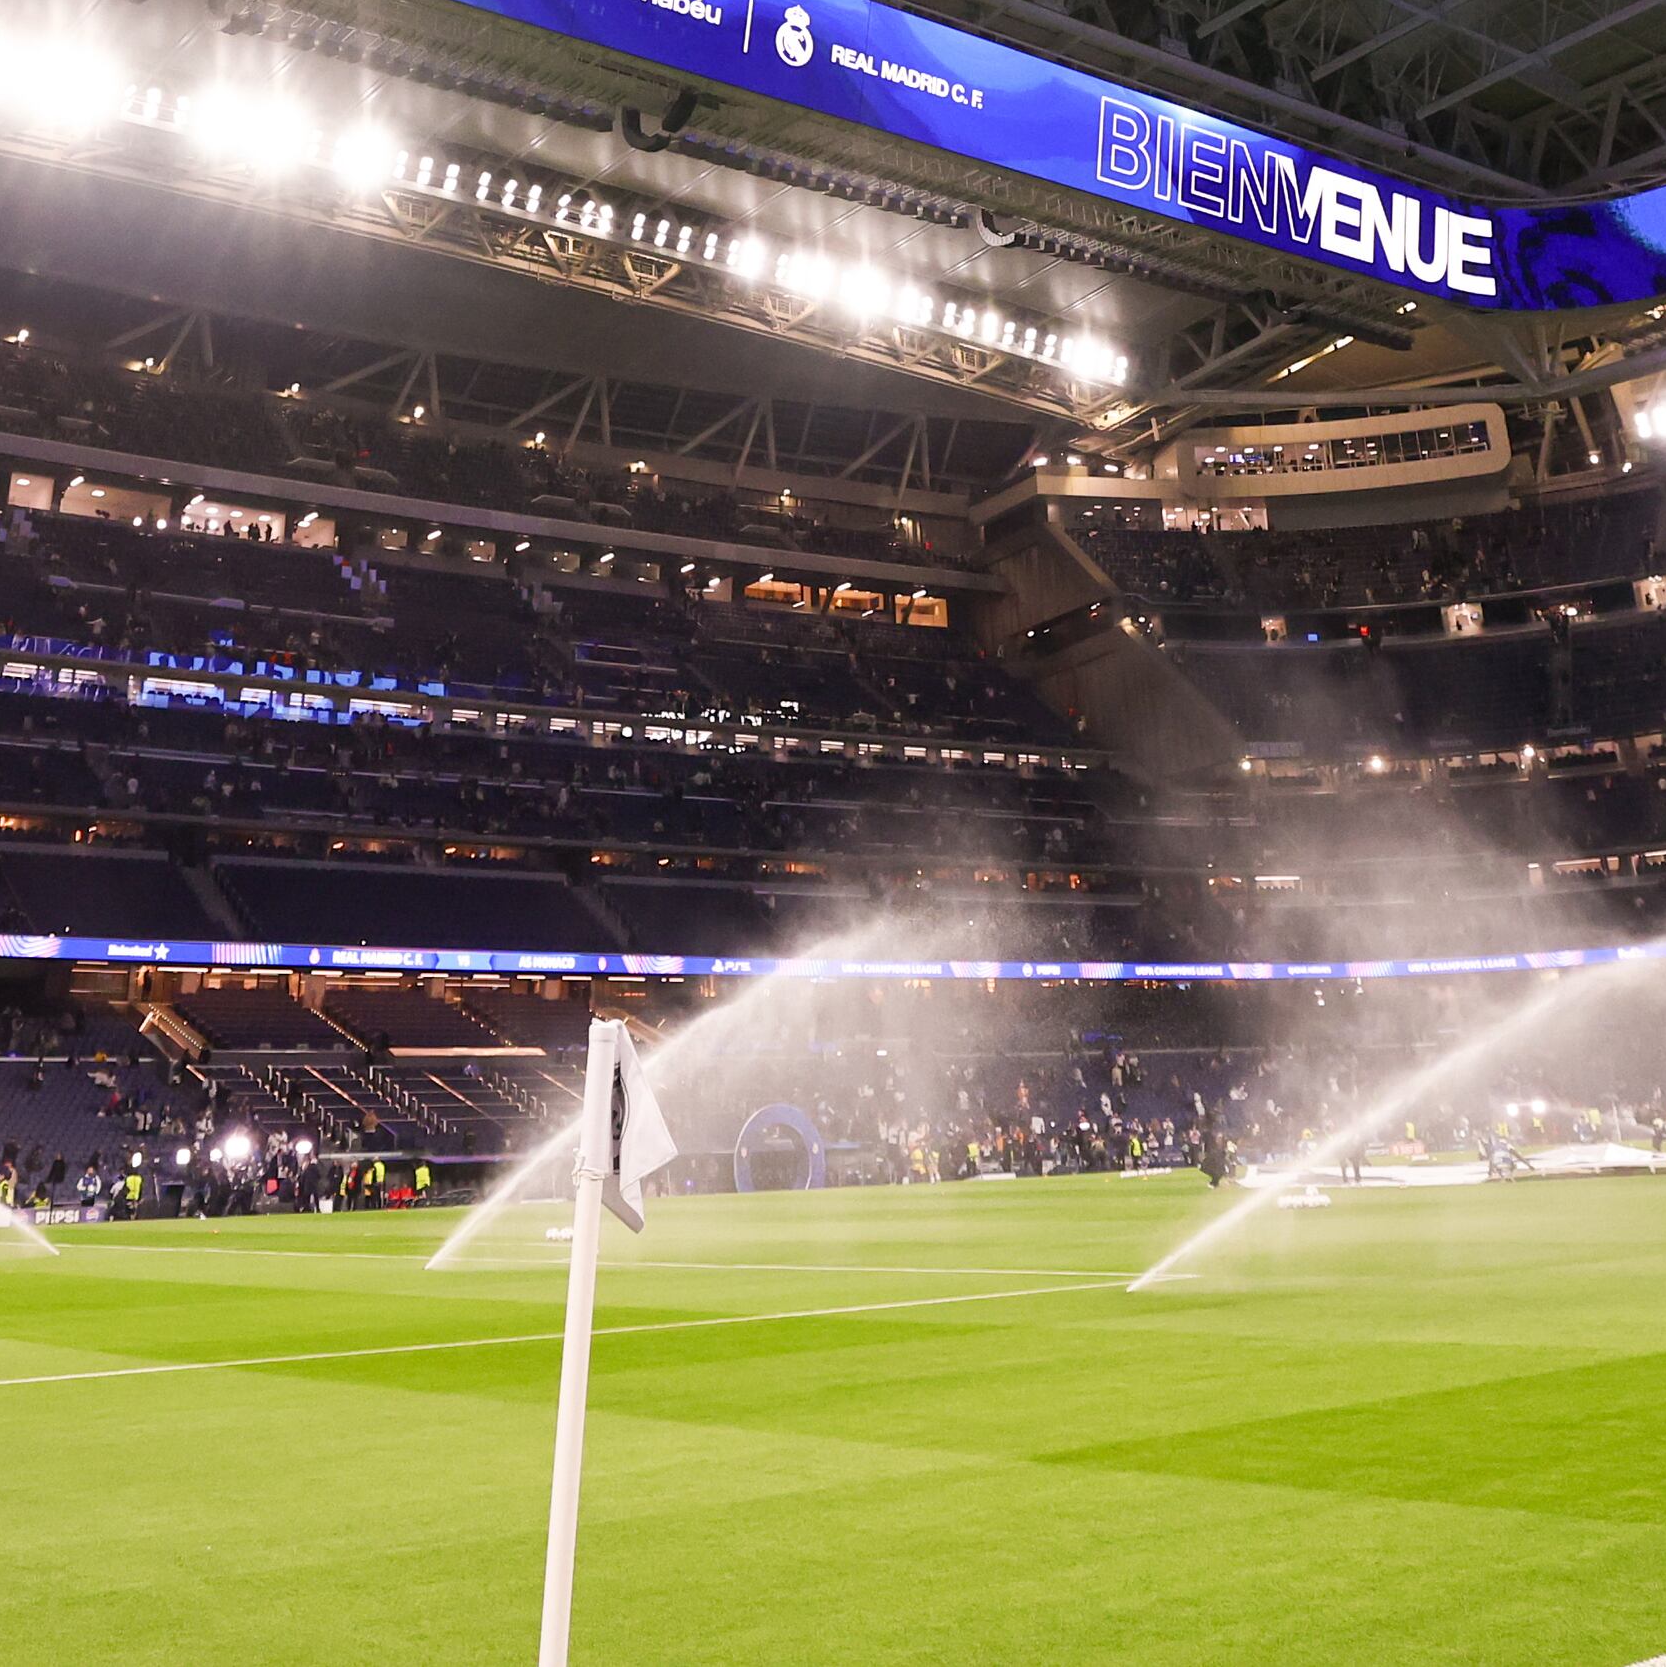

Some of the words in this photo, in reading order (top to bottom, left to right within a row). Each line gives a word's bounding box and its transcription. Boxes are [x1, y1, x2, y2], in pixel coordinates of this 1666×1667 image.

[830, 43, 878, 77] REAL
[881, 56, 948, 98] MADRID
[951, 81, 969, 107] C.
[971, 88, 984, 110] F.
[1096, 95, 1497, 296] BIENVENUE
[332, 950, 360, 965] REAL
[518, 956, 531, 969] AS
[532, 957, 575, 970] MONACO
[35, 1209, 80, 1224] PEPSI
